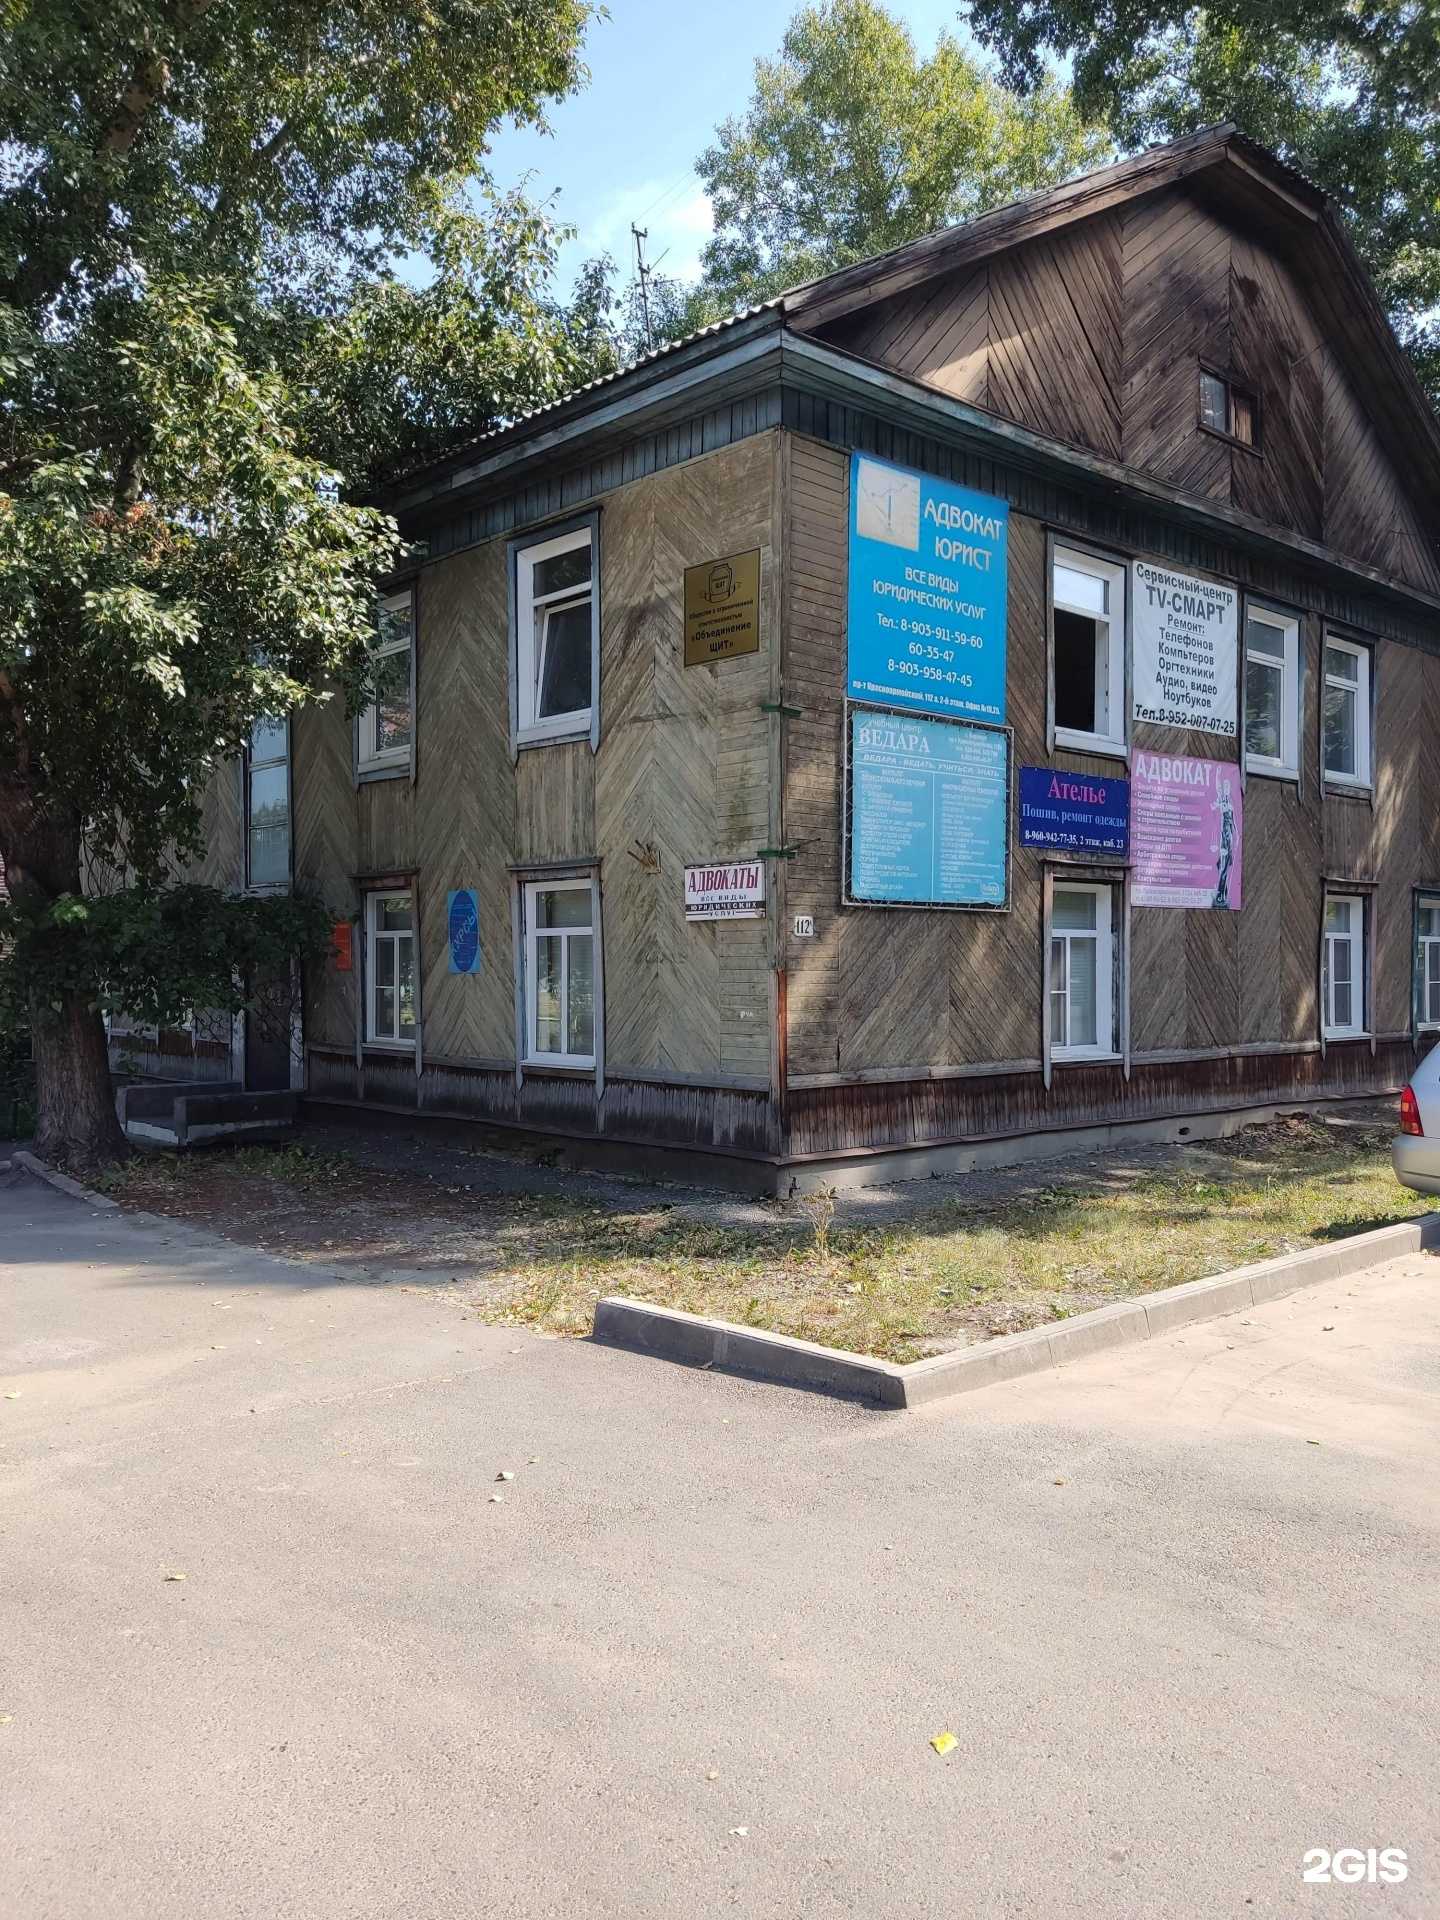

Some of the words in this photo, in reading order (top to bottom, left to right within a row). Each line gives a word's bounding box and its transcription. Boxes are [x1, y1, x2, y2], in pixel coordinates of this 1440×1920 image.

[924, 498, 1003, 541] АДВОКАТ
[935, 536, 992, 571] ЮРИСТ
[905, 567, 926, 584] ВСЕ
[928, 574, 959, 593] ВИДЫ
[873, 579, 953, 611] ЮРИДИЧЕСКИХ
[956, 602, 987, 620] УСЛУГ
[1146, 584, 1226, 624] TV-СМАРТ
[900, 618, 983, 648] 8-903-911-59-60
[1168, 613, 1205, 634] Ремонт:
[1159, 626, 1214, 651] Телефонов
[1158, 642, 1214, 666] Компьтеров
[888, 659, 973, 687] 8-903-958-47-45
[1158, 658, 1215, 679] Оргтехники
[1155, 671, 1188, 691] Аудио,
[1190, 681, 1218, 696] видео
[1163, 688, 1212, 709] Ноутбуков
[858, 727, 930, 752] ВЕДАРА
[863, 753, 897, 765] ВЕДАРА
[1135, 754, 1212, 787] АДВОКАТ
[1048, 775, 1106, 804] Ателье
[1022, 803, 1060, 820] Пошив,
[1061, 810, 1094, 824] ремонт
[1095, 816, 1127, 828] одежды
[1079, 835, 1084, 845] 2
[1116, 839, 1124, 849] 23
[688, 866, 760, 895] АДВОКАТЫ
[690, 903, 757, 911] ЮРИДИЧЕСКИХ
